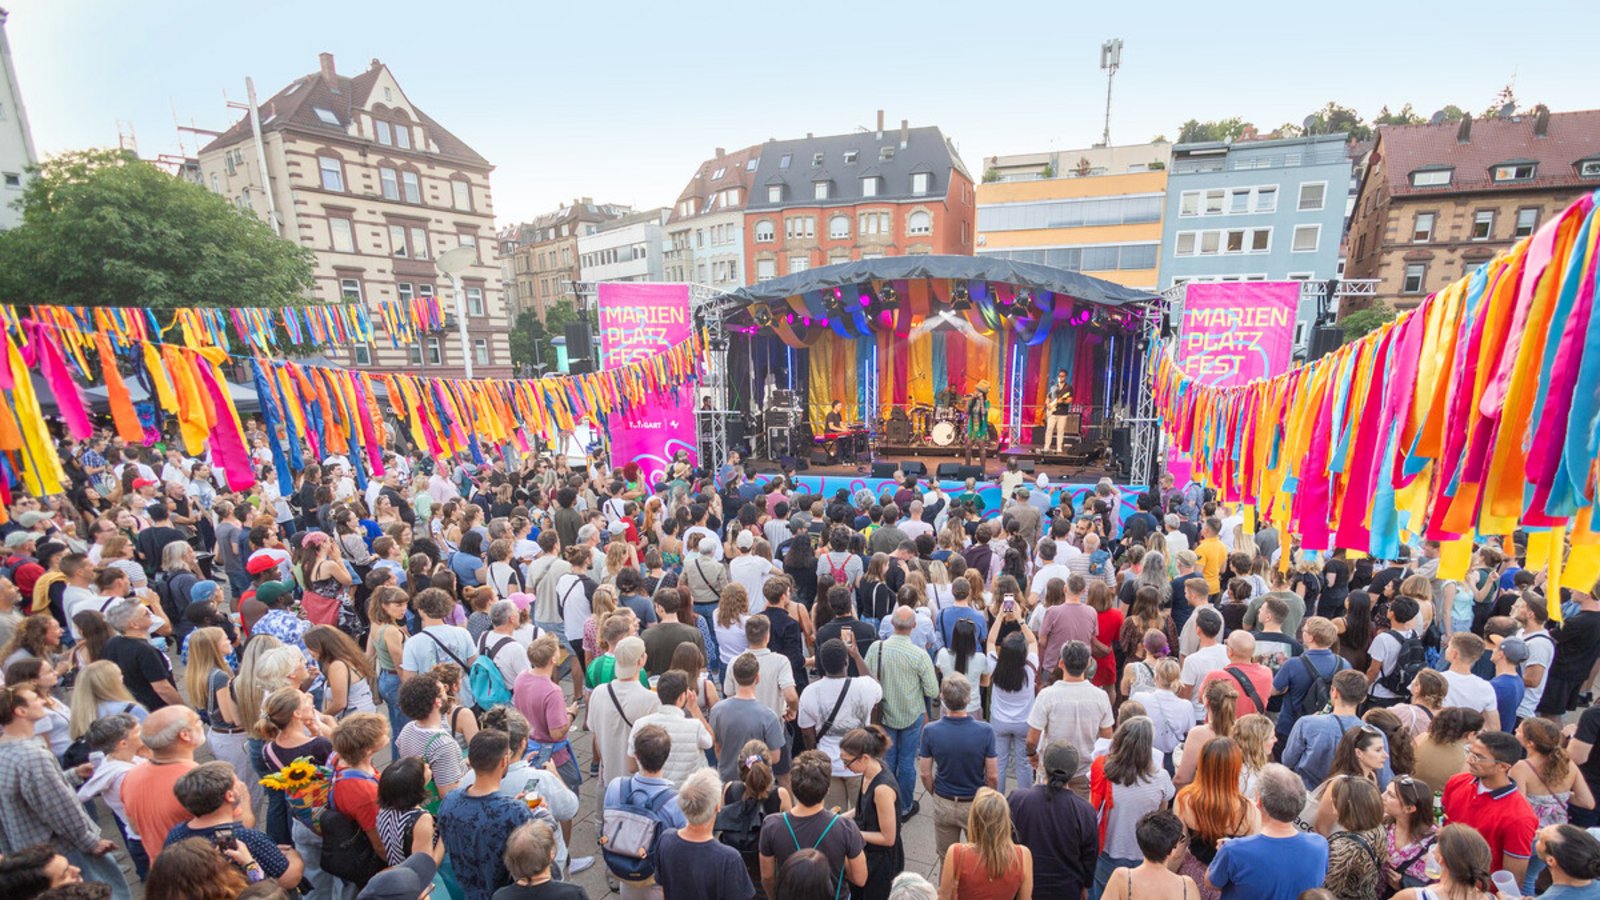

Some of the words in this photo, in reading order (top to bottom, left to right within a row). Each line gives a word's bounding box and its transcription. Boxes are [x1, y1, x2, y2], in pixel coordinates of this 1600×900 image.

[606, 305, 684, 324] MARIEN
[1190, 307, 1289, 327] MARIEN
[607, 327, 667, 345] PLATZ
[1187, 331, 1263, 351] PLATZ
[1185, 355, 1246, 375] FEST
